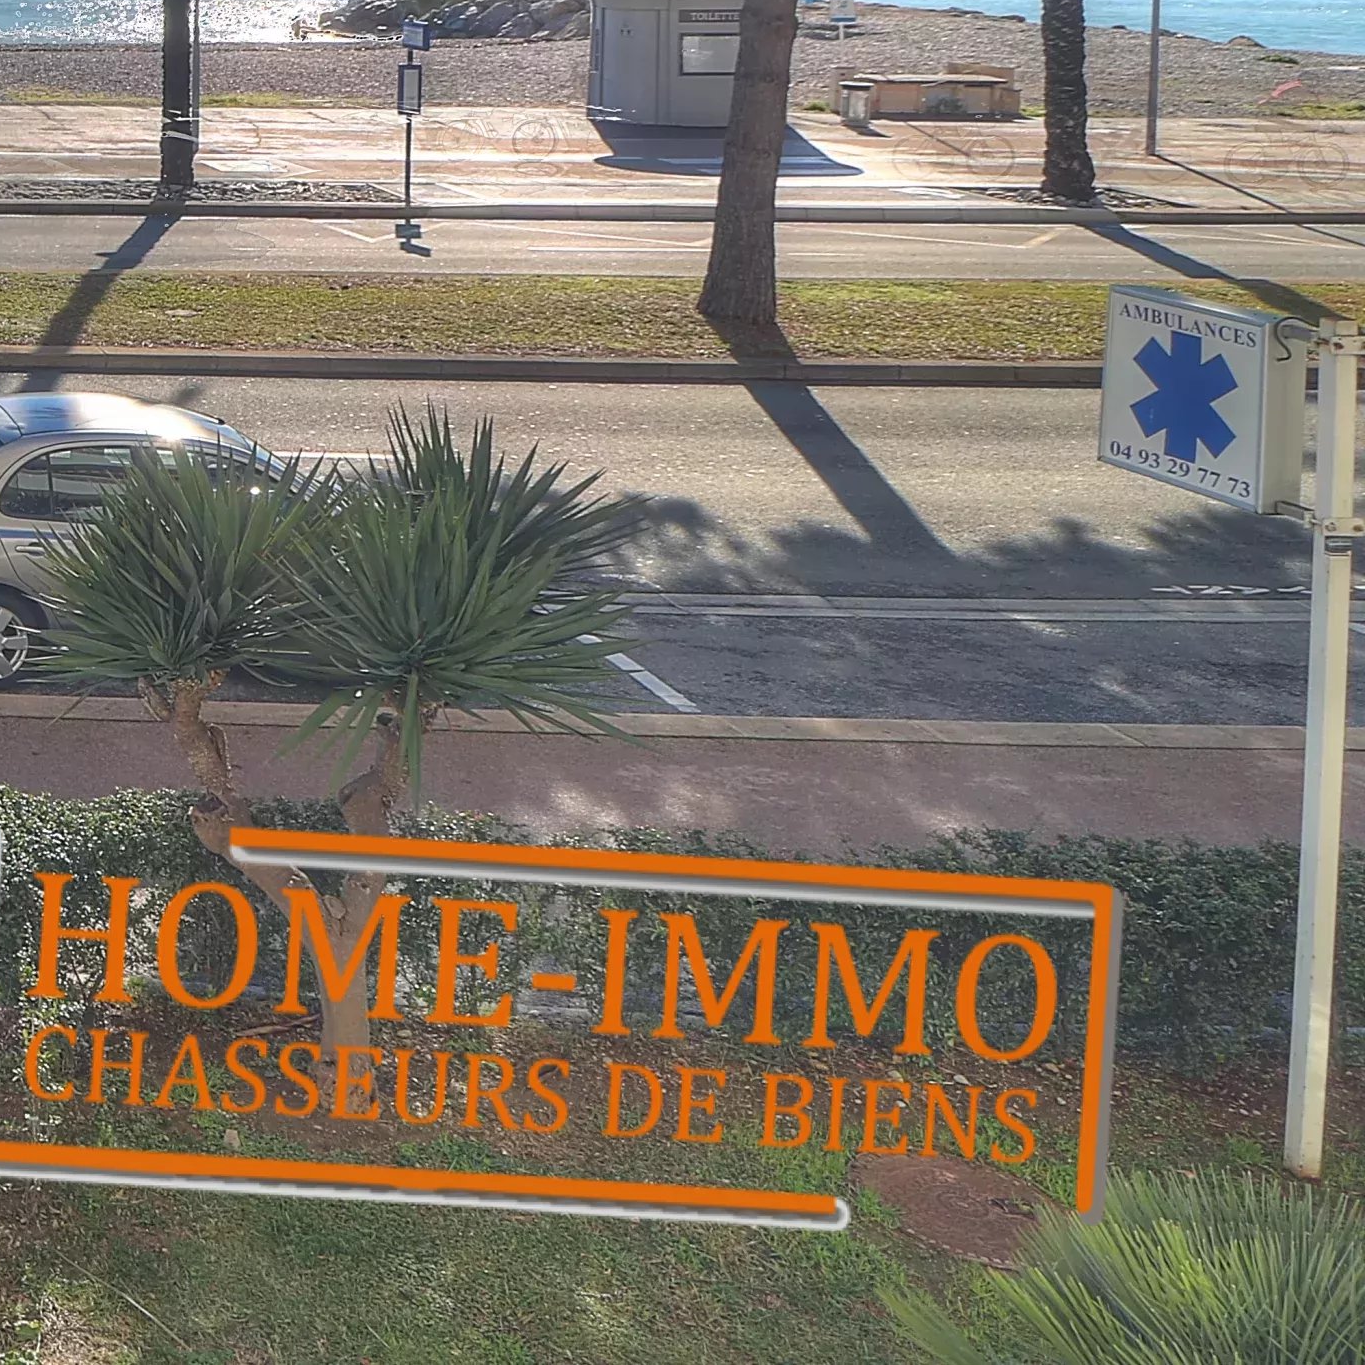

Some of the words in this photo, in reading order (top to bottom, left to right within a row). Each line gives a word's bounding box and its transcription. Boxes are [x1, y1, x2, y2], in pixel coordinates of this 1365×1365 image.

[1119, 303, 1257, 349] AMBULANCES
[1110, 440, 1132, 460] 04
[1138, 448, 1160, 469] 93
[1166, 458, 1191, 478] 29
[1197, 467, 1221, 488] 77
[1227, 477, 1251, 498] 73
